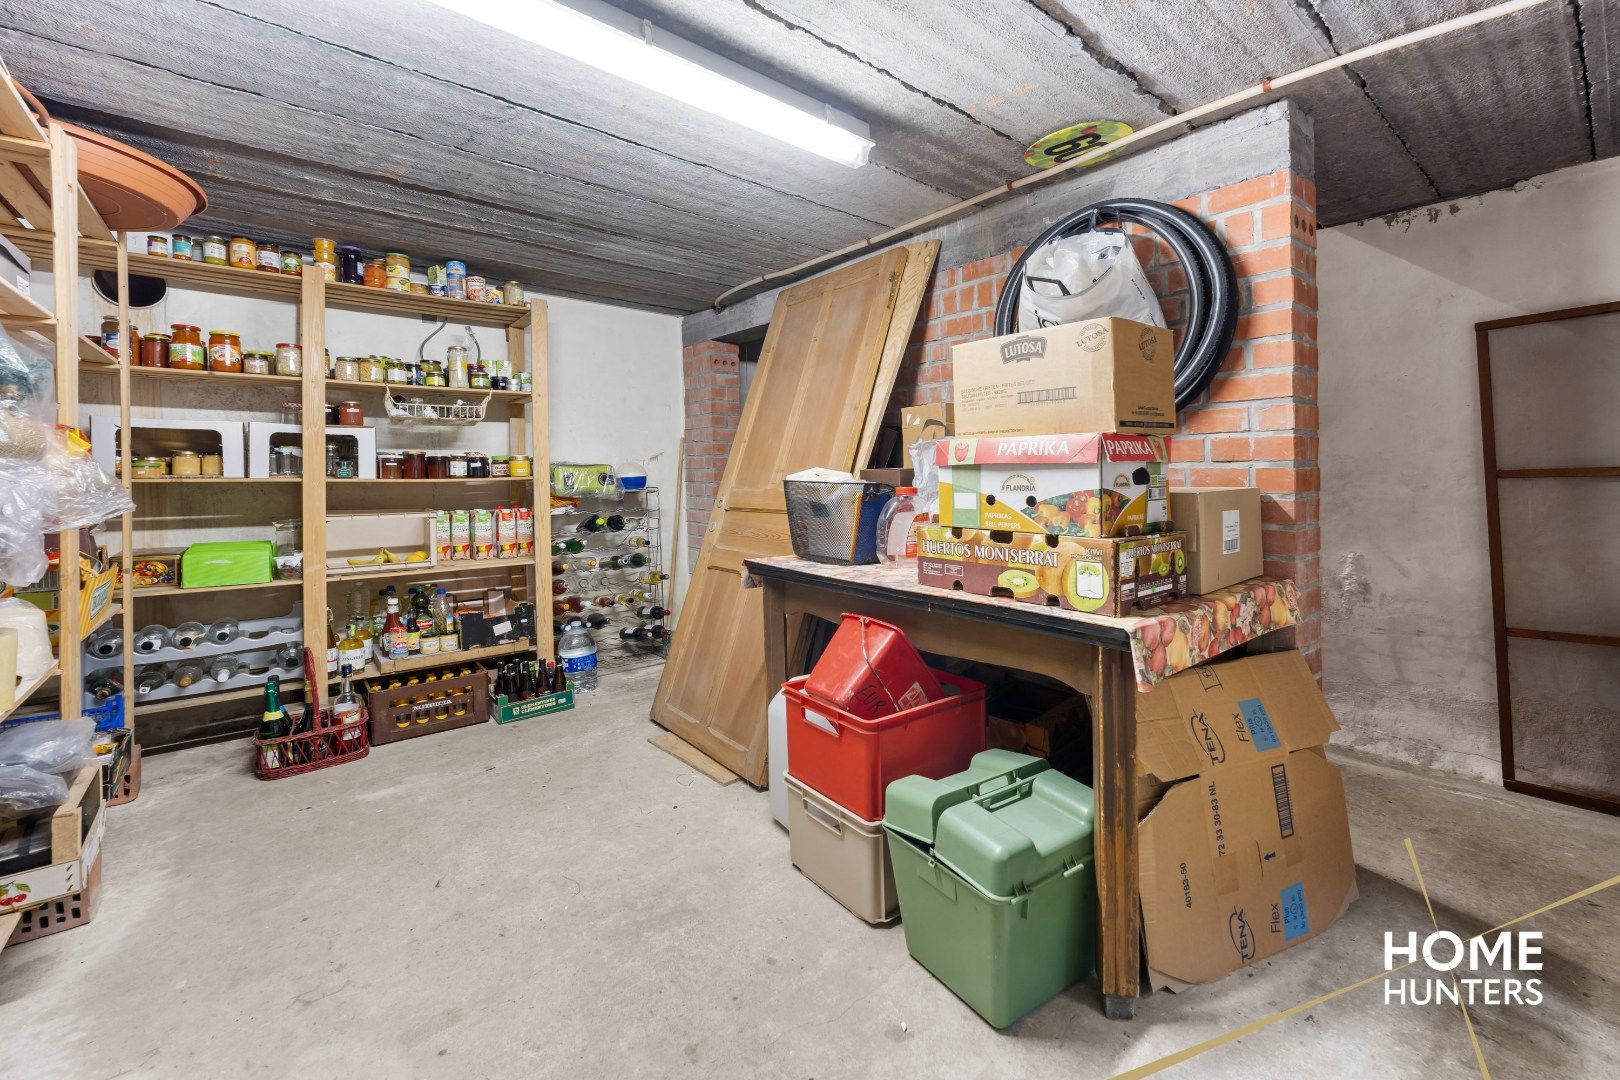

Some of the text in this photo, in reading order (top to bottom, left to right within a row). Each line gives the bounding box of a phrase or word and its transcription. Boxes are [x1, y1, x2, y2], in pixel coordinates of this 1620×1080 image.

[1005, 341, 1042, 357] LUTOSA
[1076, 327, 1109, 347] LUTOSA
[997, 440, 1070, 456] PAPRIKA
[1108, 439, 1153, 456] PAPRIKA
[1006, 484, 1036, 492] FLANDRIA
[922, 540, 971, 558] HUERTOS
[974, 545, 1059, 567] MONTSERRAT
[412, 699, 452, 711] NUTRICIA
[1199, 713, 1219, 766] TENA
[1232, 713, 1250, 742] Flex
[1208, 781, 1226, 856] 72 33 30-83 NL
[1180, 863, 1192, 908] 40183-50
[1271, 903, 1281, 934] Flex
[1238, 908, 1248, 964] TENA
